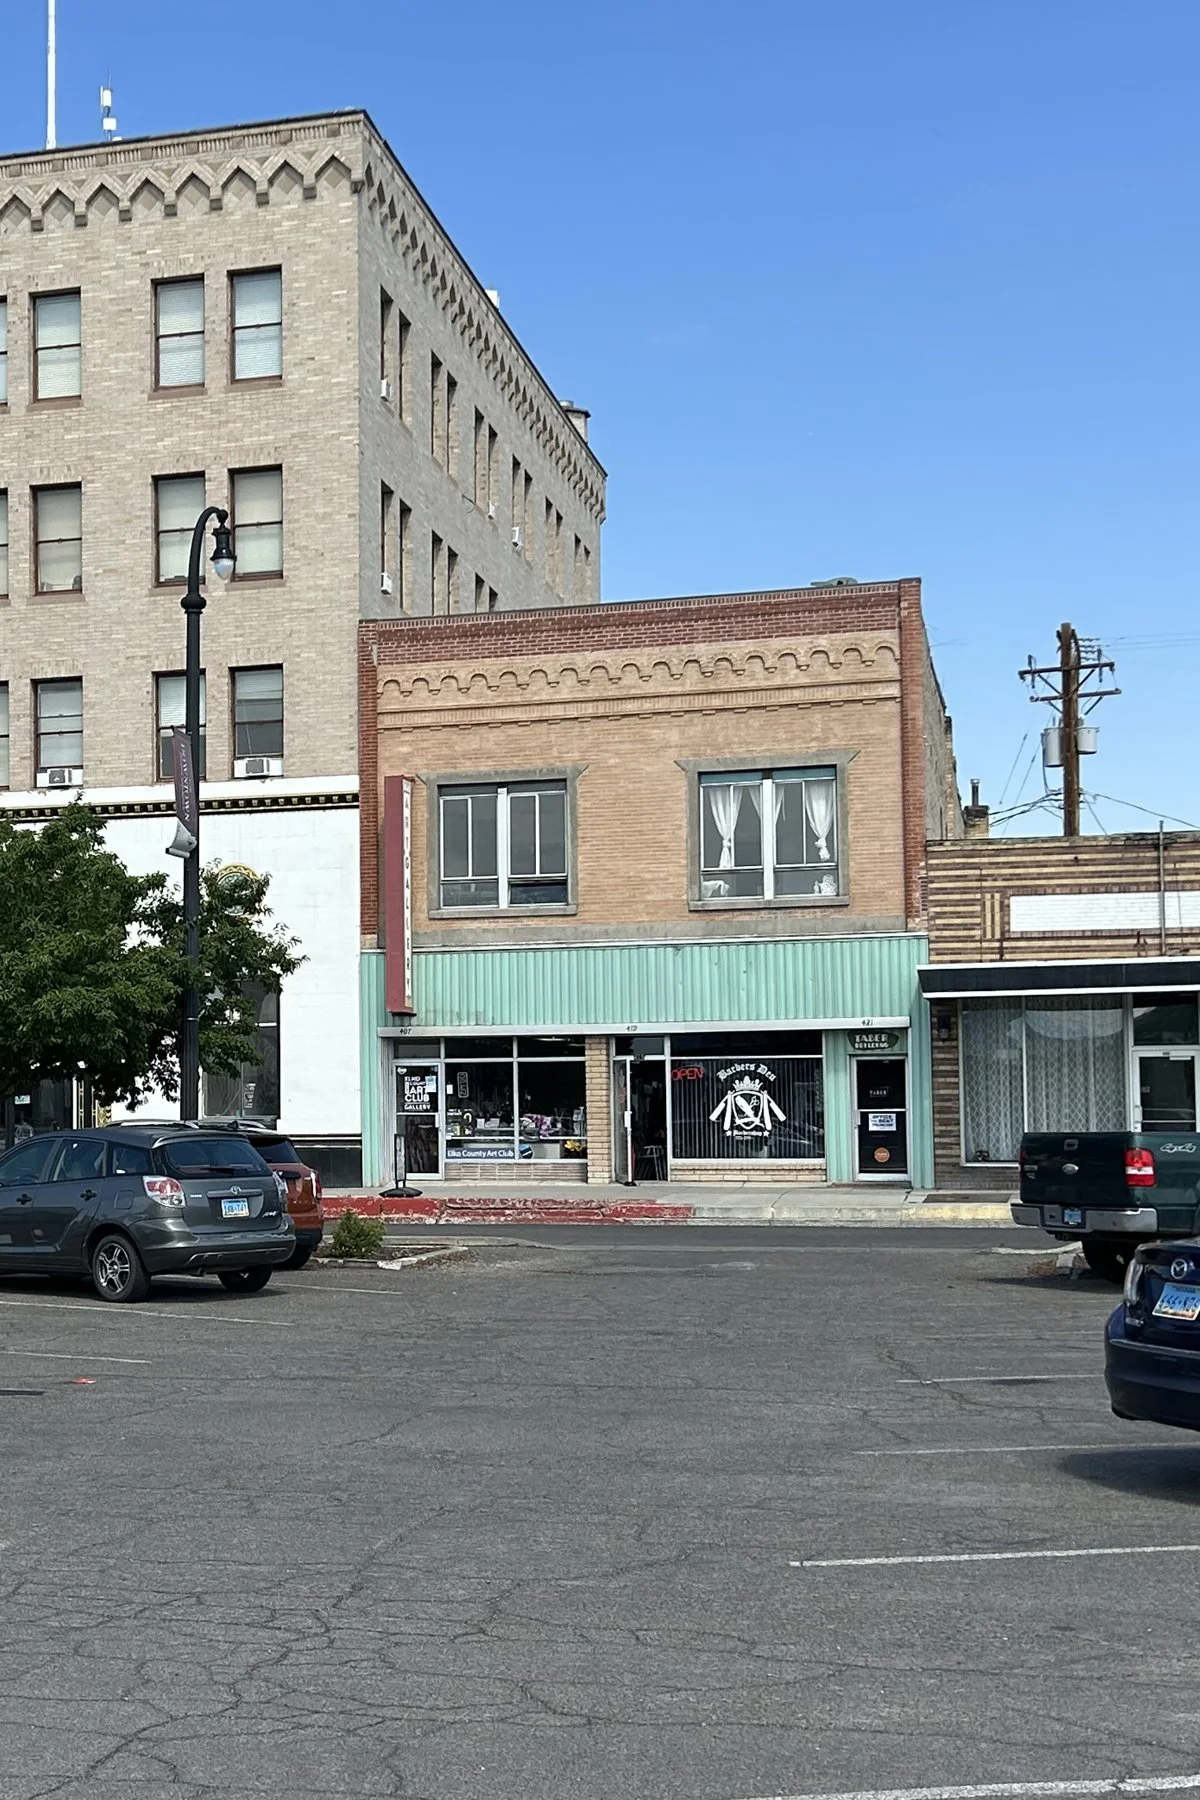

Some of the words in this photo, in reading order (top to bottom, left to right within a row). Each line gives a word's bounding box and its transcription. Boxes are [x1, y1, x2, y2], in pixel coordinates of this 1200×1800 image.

[855, 1034, 889, 1042] TABER
[672, 1066, 704, 1081] OPEN
[716, 1063, 756, 1082] Barbers
[404, 1093, 430, 1102] CLUB
[462, 1149, 486, 1158] County
[498, 1149, 514, 1157] Club
